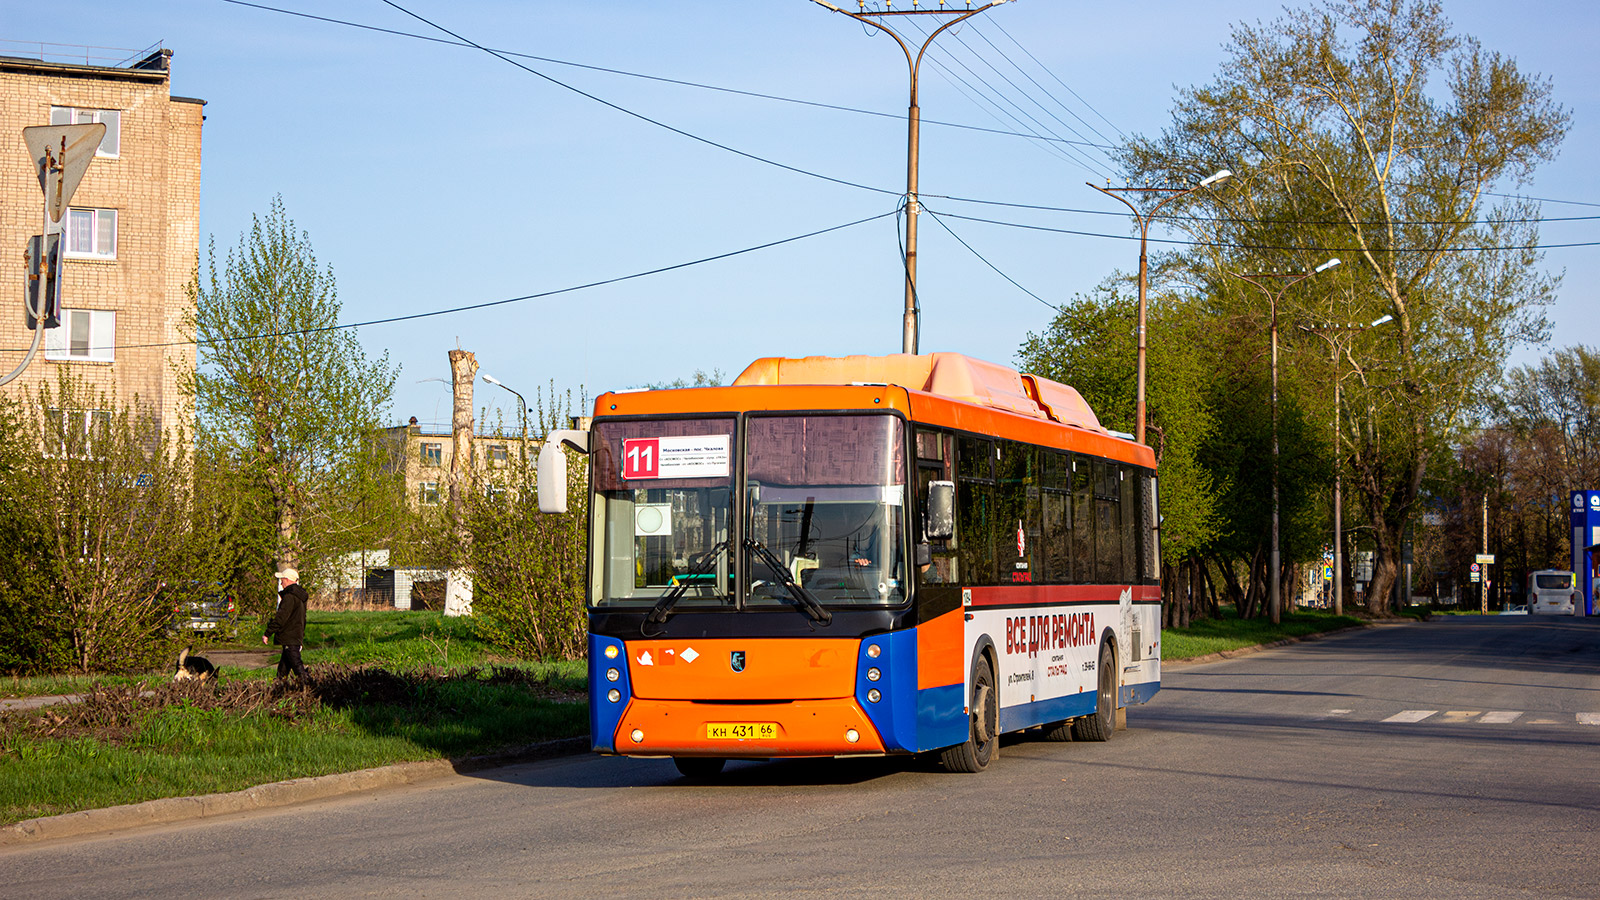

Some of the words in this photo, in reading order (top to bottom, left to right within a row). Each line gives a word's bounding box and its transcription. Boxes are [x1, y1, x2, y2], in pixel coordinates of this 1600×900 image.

[627, 445, 653, 472] 11
[1006, 616, 1027, 655] ВСЕ
[1028, 614, 1050, 659] ДЛЯ
[1052, 613, 1096, 649] РЕМОНТА
[712, 728, 727, 737] КН
[732, 725, 753, 737] 431
[760, 724, 772, 734] 66
